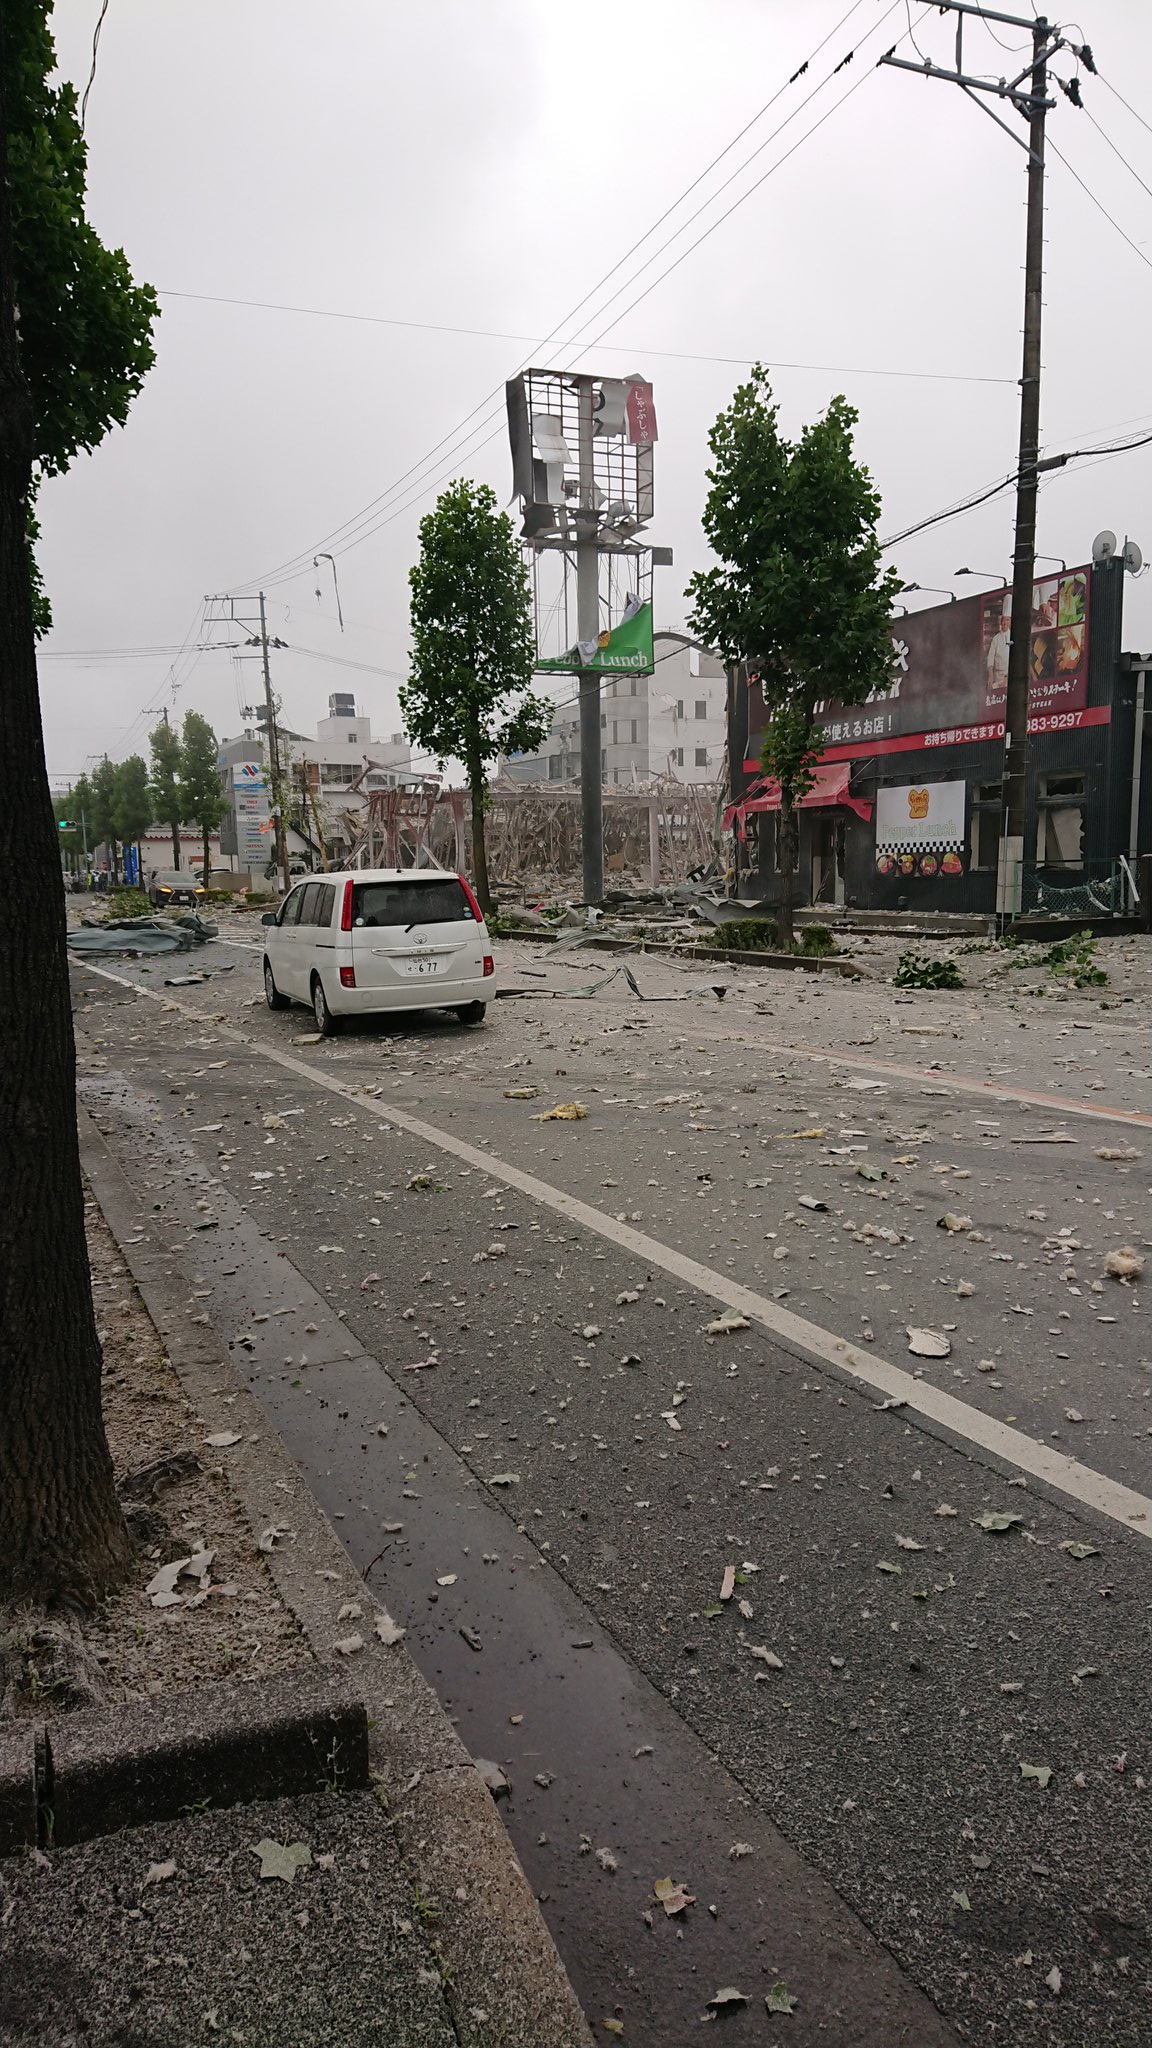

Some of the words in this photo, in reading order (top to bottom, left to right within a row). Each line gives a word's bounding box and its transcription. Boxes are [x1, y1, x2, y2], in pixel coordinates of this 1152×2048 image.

[600, 651, 648, 668] Lunch
[924, 724, 996, 746] お持ち帰りできます
